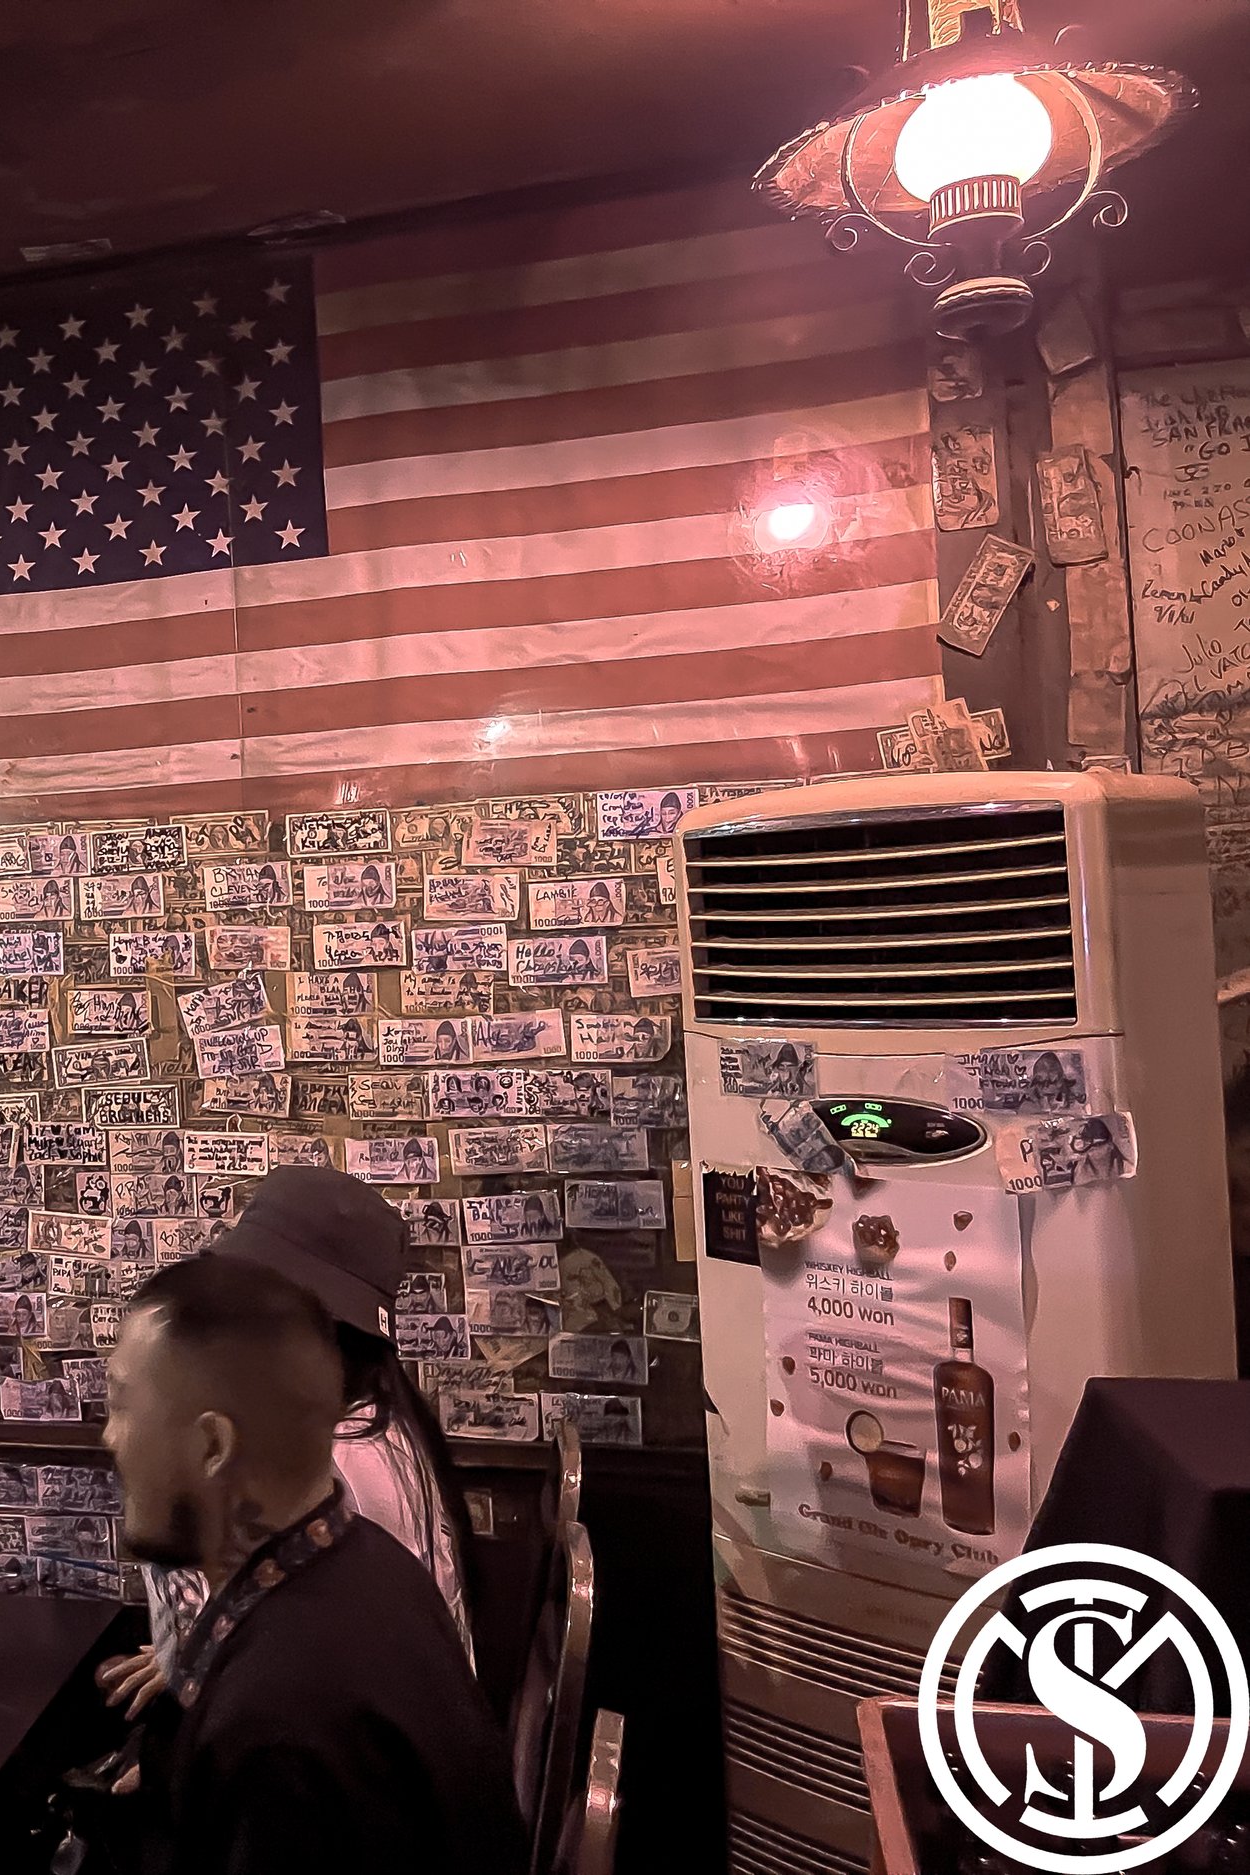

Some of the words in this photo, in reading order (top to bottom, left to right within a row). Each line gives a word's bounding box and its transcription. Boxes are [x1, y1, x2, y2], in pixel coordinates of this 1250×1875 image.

[308, 900, 330, 909] 1000
[113, 966, 133, 975] 1000
[382, 1054, 405, 1062] 1000
[575, 1051, 599, 1060] 1000
[952, 1097, 985, 1110] 1000
[720, 1177, 745, 1189] YOU
[1008, 1175, 1042, 1191] 1000
[470, 1232, 493, 1242] 1000
[160, 1252, 181, 1260] 1000
[805, 1261, 843, 1275] WHISKEY
[806, 1273, 846, 1292] 위스키
[807, 1297, 854, 1319] 4,000
[857, 1307, 895, 1326] won
[810, 1367, 857, 1392] 5,000
[860, 1380, 898, 1399] won
[940, 1386, 986, 1408] PAMA
